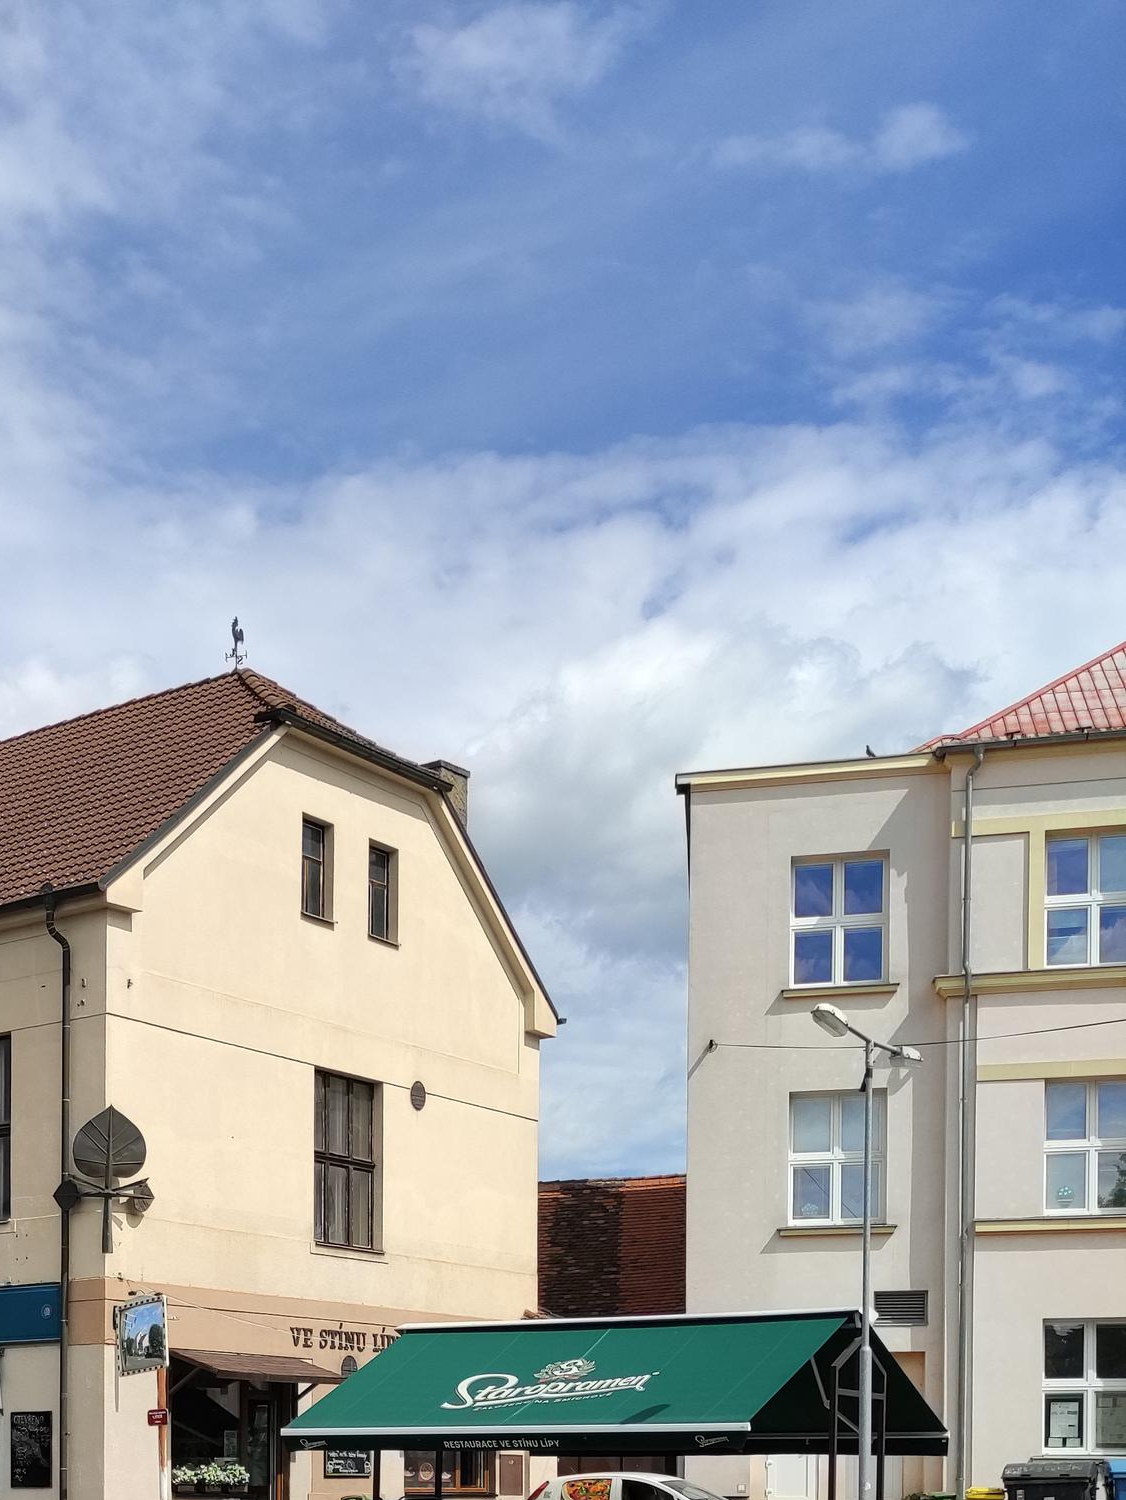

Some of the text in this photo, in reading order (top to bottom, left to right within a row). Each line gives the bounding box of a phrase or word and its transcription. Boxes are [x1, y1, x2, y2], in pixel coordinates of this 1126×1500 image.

[290, 1326, 313, 1349] VE
[319, 1322, 367, 1353] STÍNU
[440, 1371, 653, 1410] Staropramen
[443, 1437, 560, 1450] RESTAURACE VE STÍNU LÍPY
